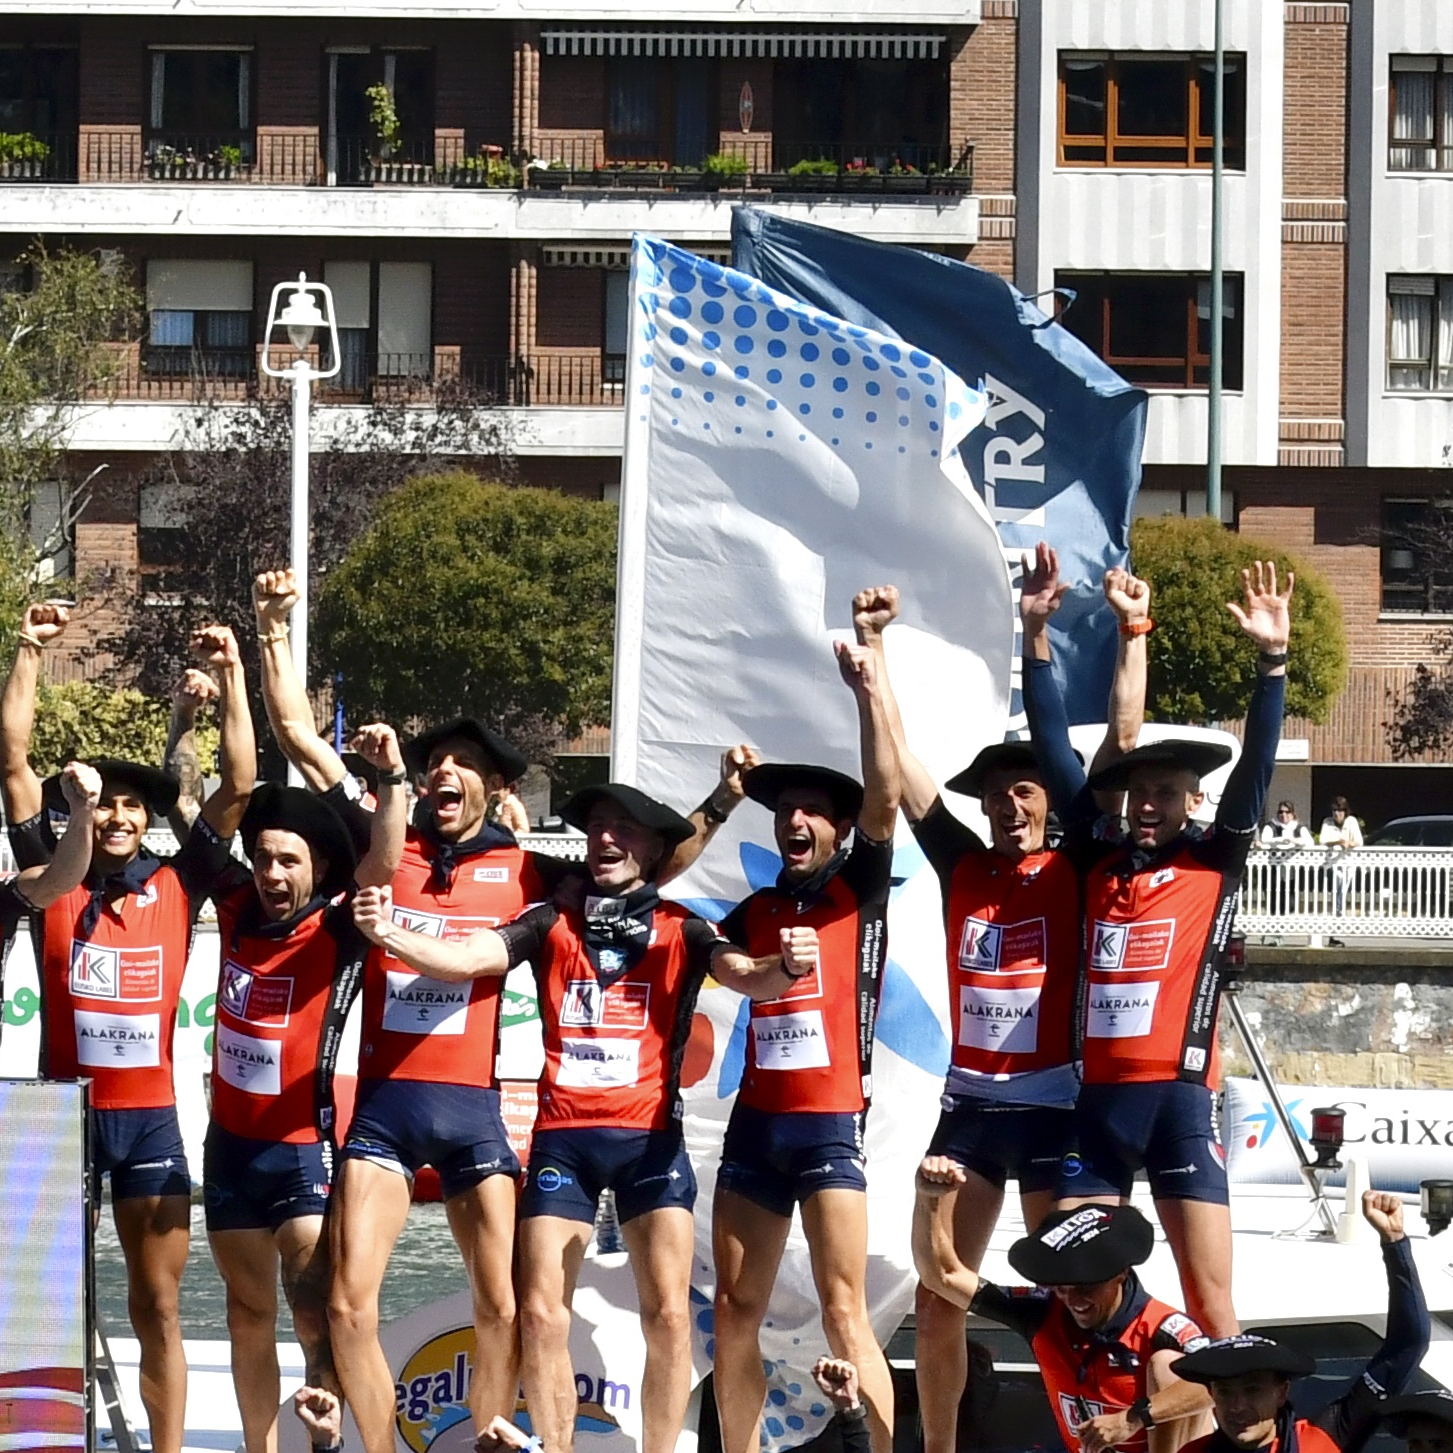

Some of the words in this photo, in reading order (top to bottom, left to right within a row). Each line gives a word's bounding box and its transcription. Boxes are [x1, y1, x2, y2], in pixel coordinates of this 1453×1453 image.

[389, 989, 465, 1004] ALAKRANA
[963, 1003, 1034, 1019] ALAKRANA
[80, 1028, 156, 1041] ALAKRANA
